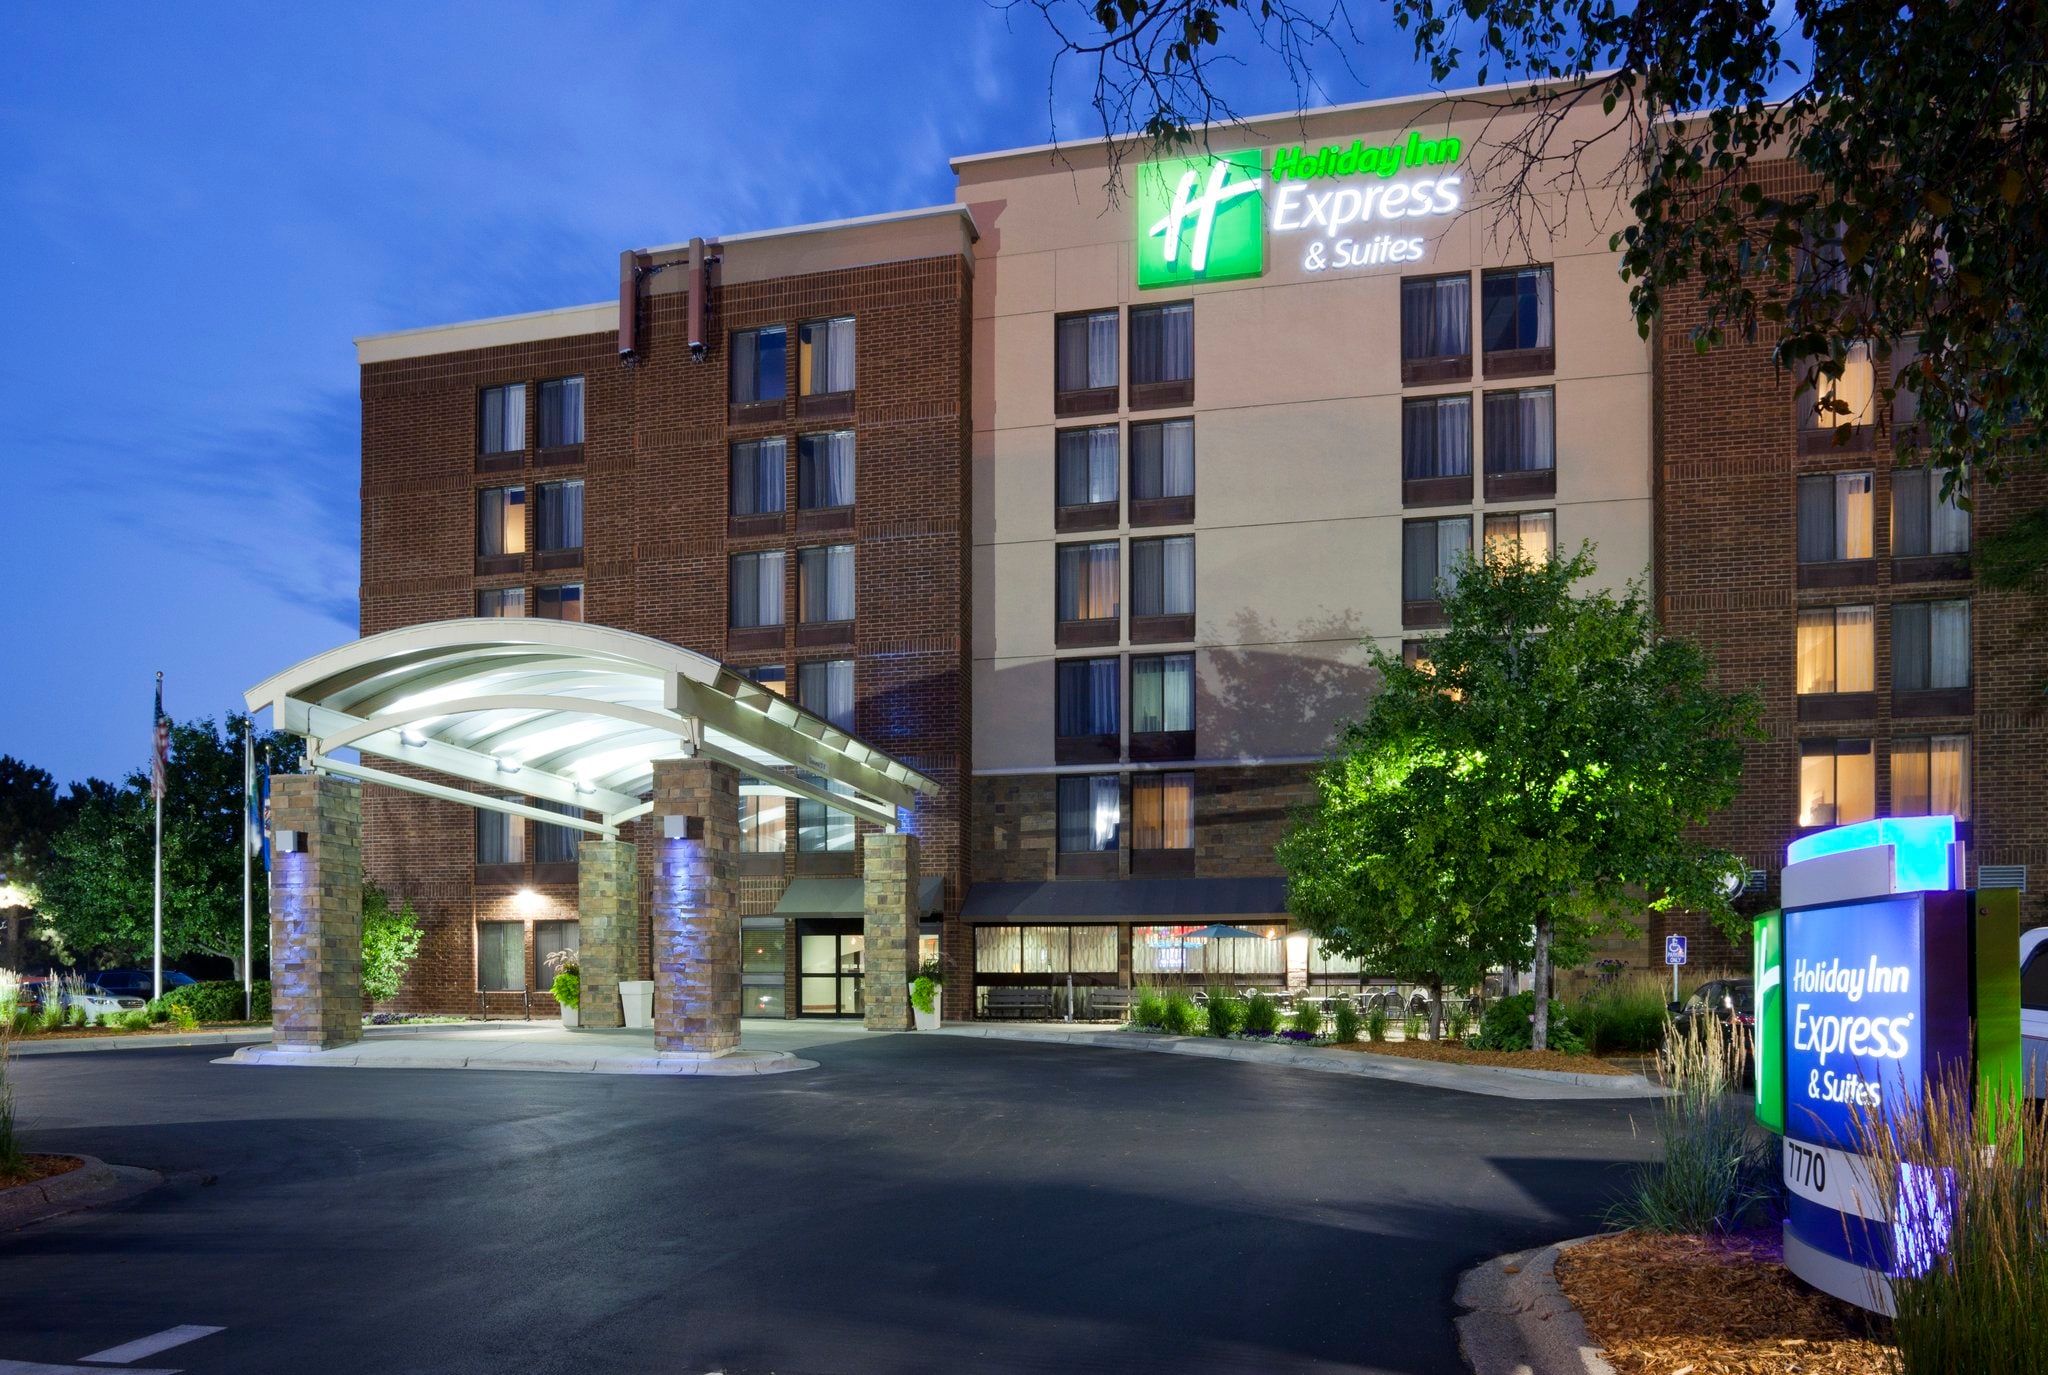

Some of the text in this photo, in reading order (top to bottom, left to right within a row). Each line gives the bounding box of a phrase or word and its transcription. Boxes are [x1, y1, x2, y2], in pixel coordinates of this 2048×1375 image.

[1271, 131, 1461, 180] Holiday Inn
[1272, 174, 1461, 237] Express
[1304, 235, 1423, 272] & Suites
[1793, 954, 1909, 1002] Holiday Inn
[1794, 1003, 1910, 1066] Express
[1808, 1068, 1881, 1108] & Suites
[1788, 1141, 1826, 1193] 7770
